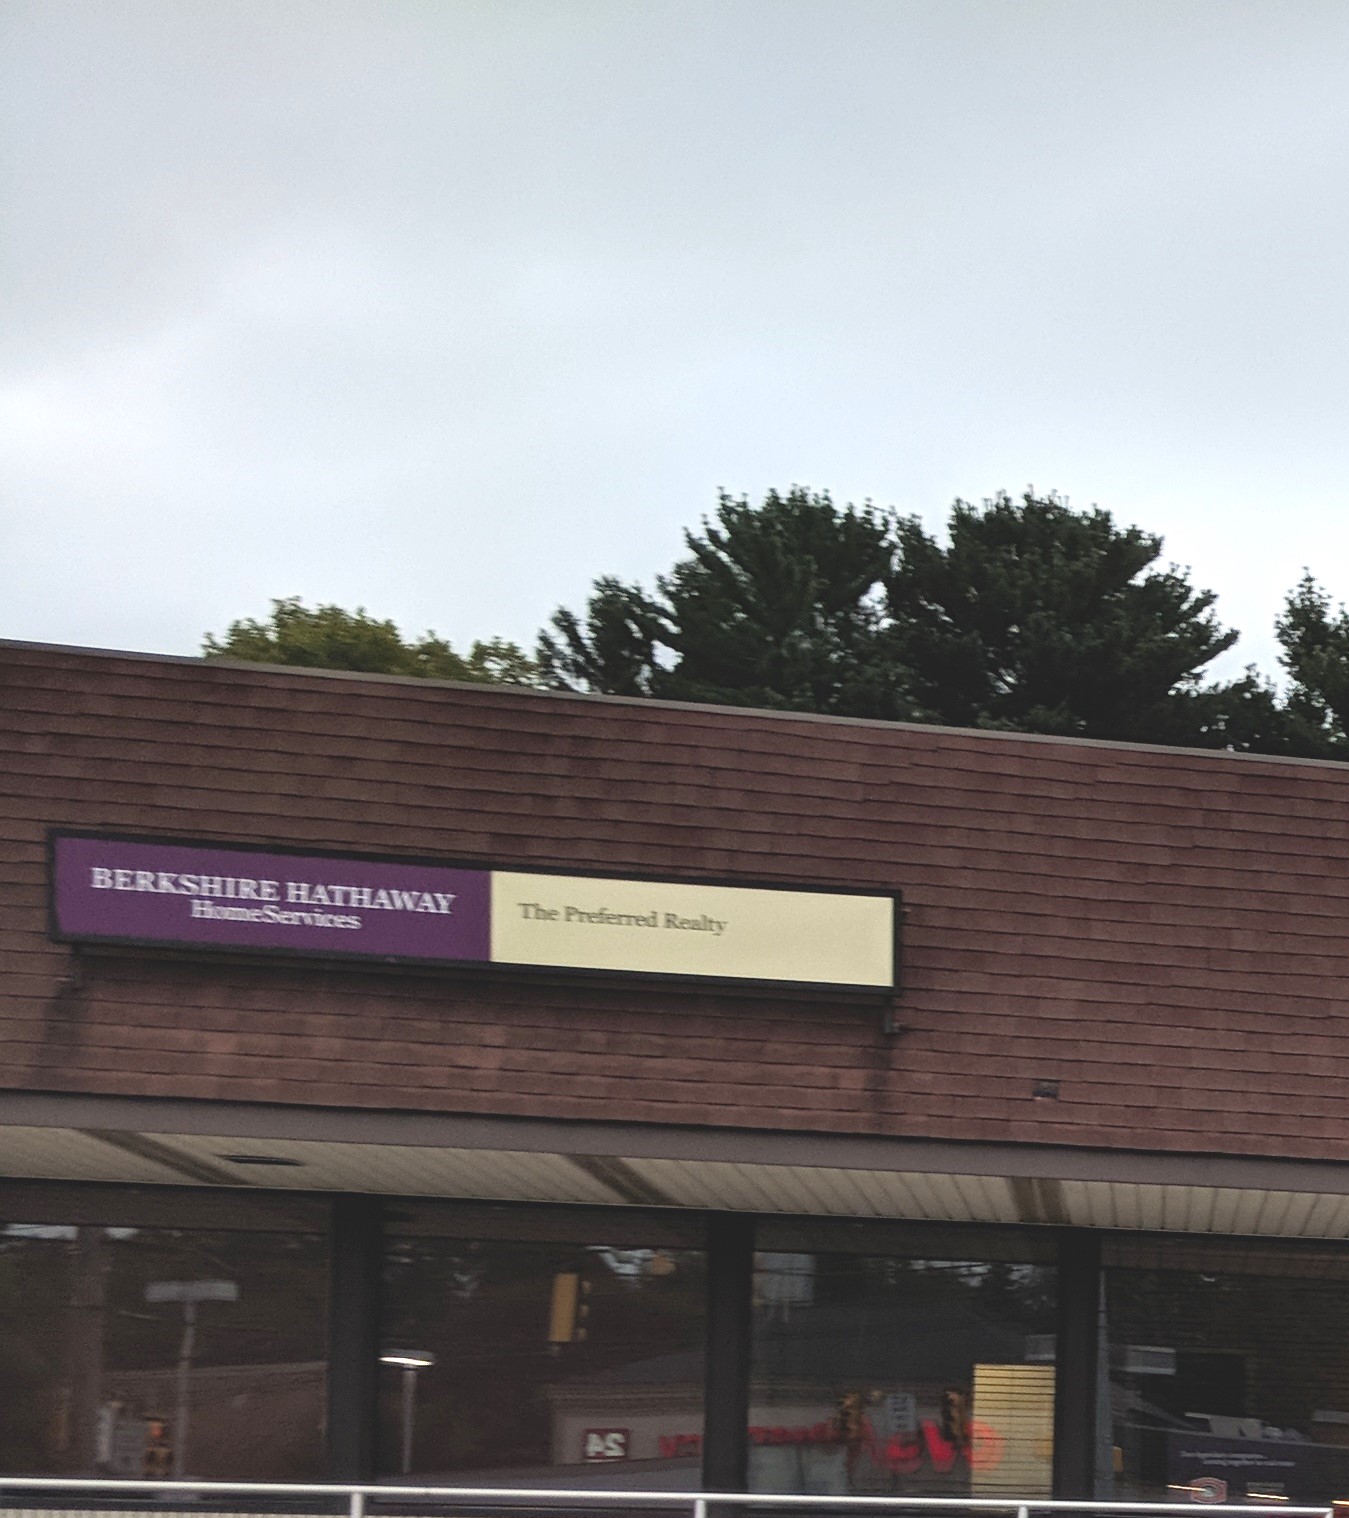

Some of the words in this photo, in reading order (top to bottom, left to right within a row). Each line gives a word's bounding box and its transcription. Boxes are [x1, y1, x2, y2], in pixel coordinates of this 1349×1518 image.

[90, 866, 280, 902] BERKSHIRE
[284, 880, 458, 915] HATHAWAY
[190, 898, 363, 930] HomeServices
[517, 902, 560, 921] The
[563, 905, 658, 928] Preferred
[663, 911, 729, 936] Realty
